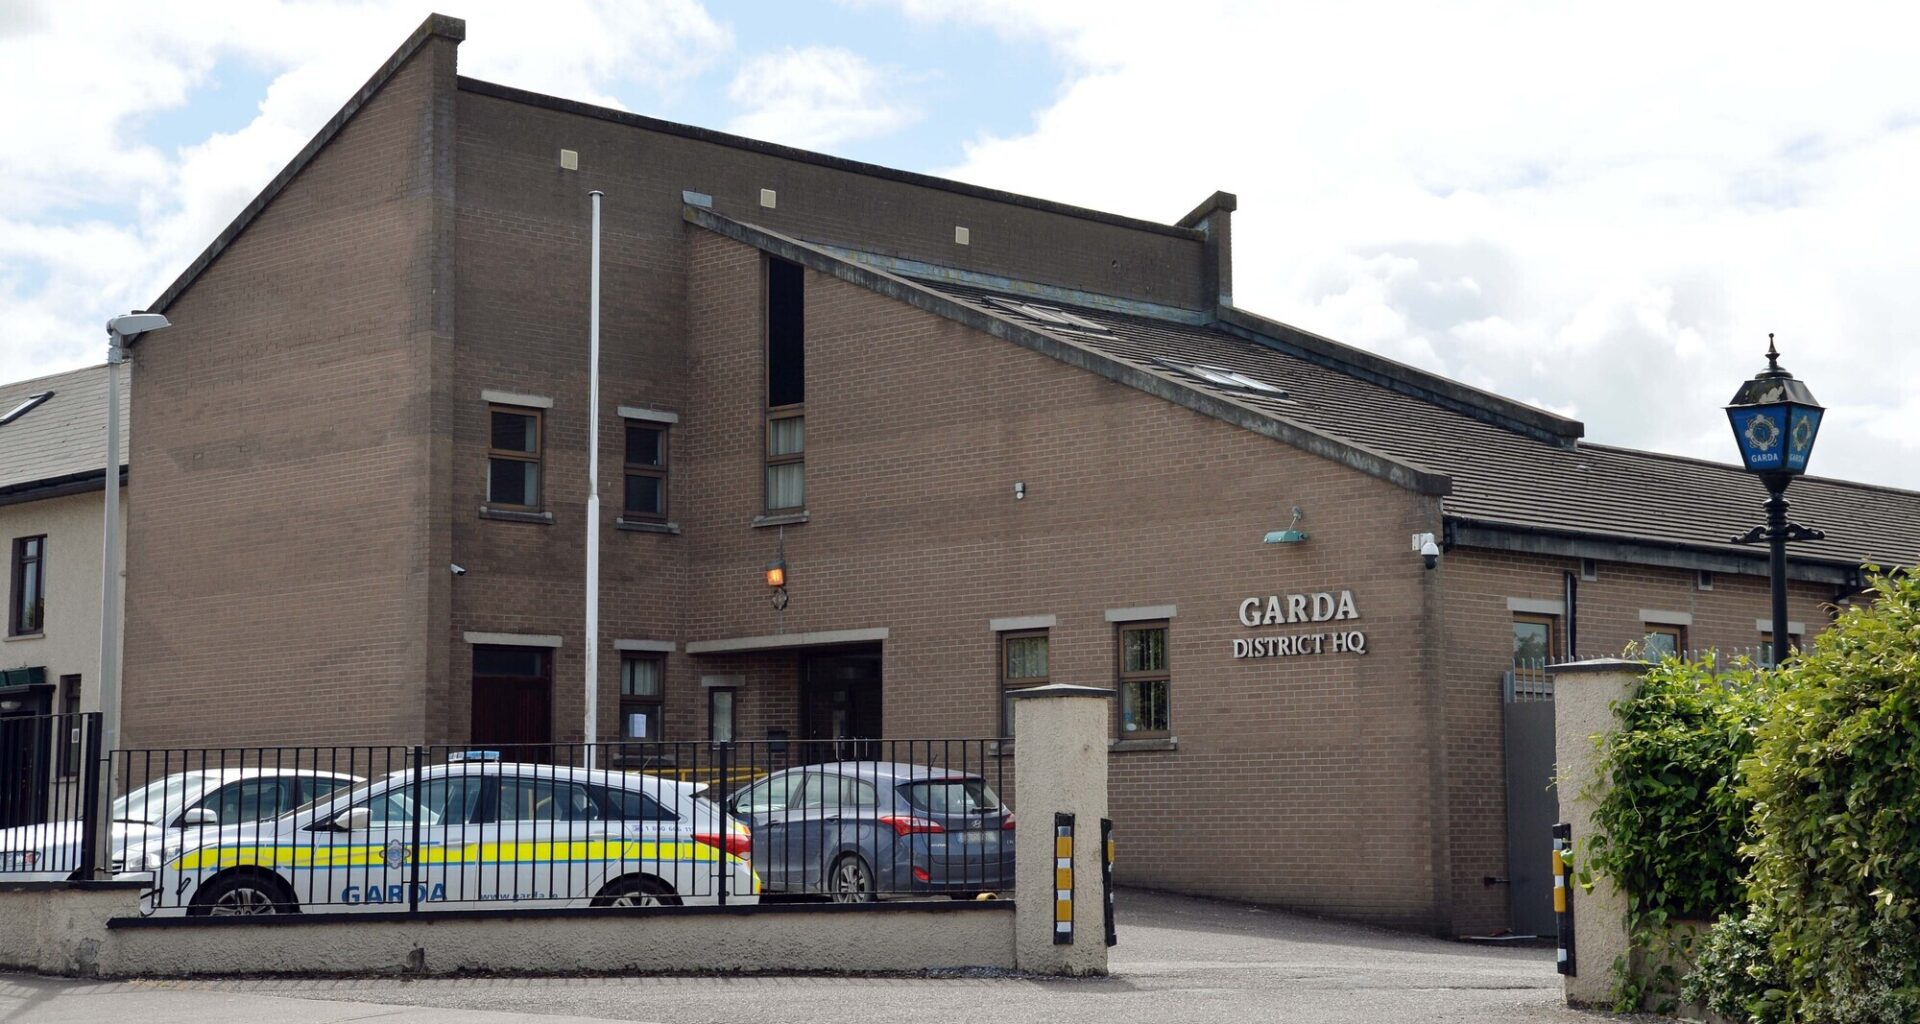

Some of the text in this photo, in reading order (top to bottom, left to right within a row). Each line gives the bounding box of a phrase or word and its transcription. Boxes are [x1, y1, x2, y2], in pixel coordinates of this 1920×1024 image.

[1751, 453, 1778, 463] GARDA
[1239, 590, 1360, 627] GARDA
[1232, 630, 1367, 658] DISTRICT HQ
[341, 883, 447, 906] GARDA
[480, 891, 558, 903] wwwgardae
